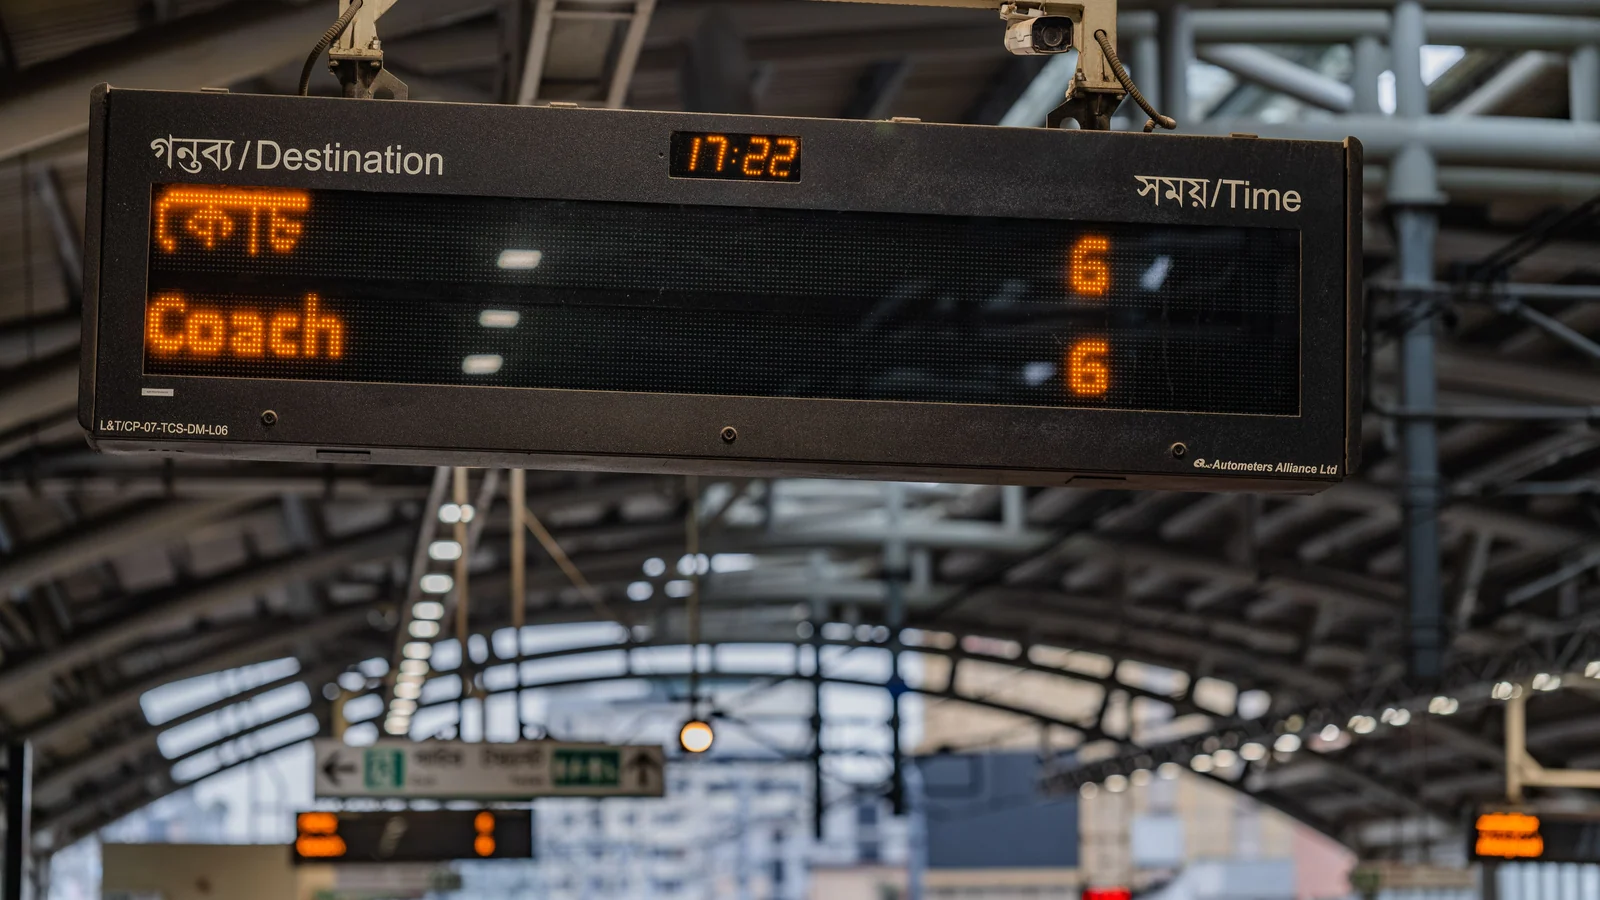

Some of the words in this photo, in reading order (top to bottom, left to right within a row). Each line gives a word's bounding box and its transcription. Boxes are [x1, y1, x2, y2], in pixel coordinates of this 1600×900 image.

[689, 135, 798, 177] 17:22
[148, 294, 344, 359] Coach
[1069, 340, 1110, 395] 6
[100, 420, 228, 436] L&T/CP-07-TCS-DM-L06
[1212, 459, 1273, 472] Autometers
[1275, 462, 1318, 474] Alliance
[1320, 464, 1338, 475] Ltd
